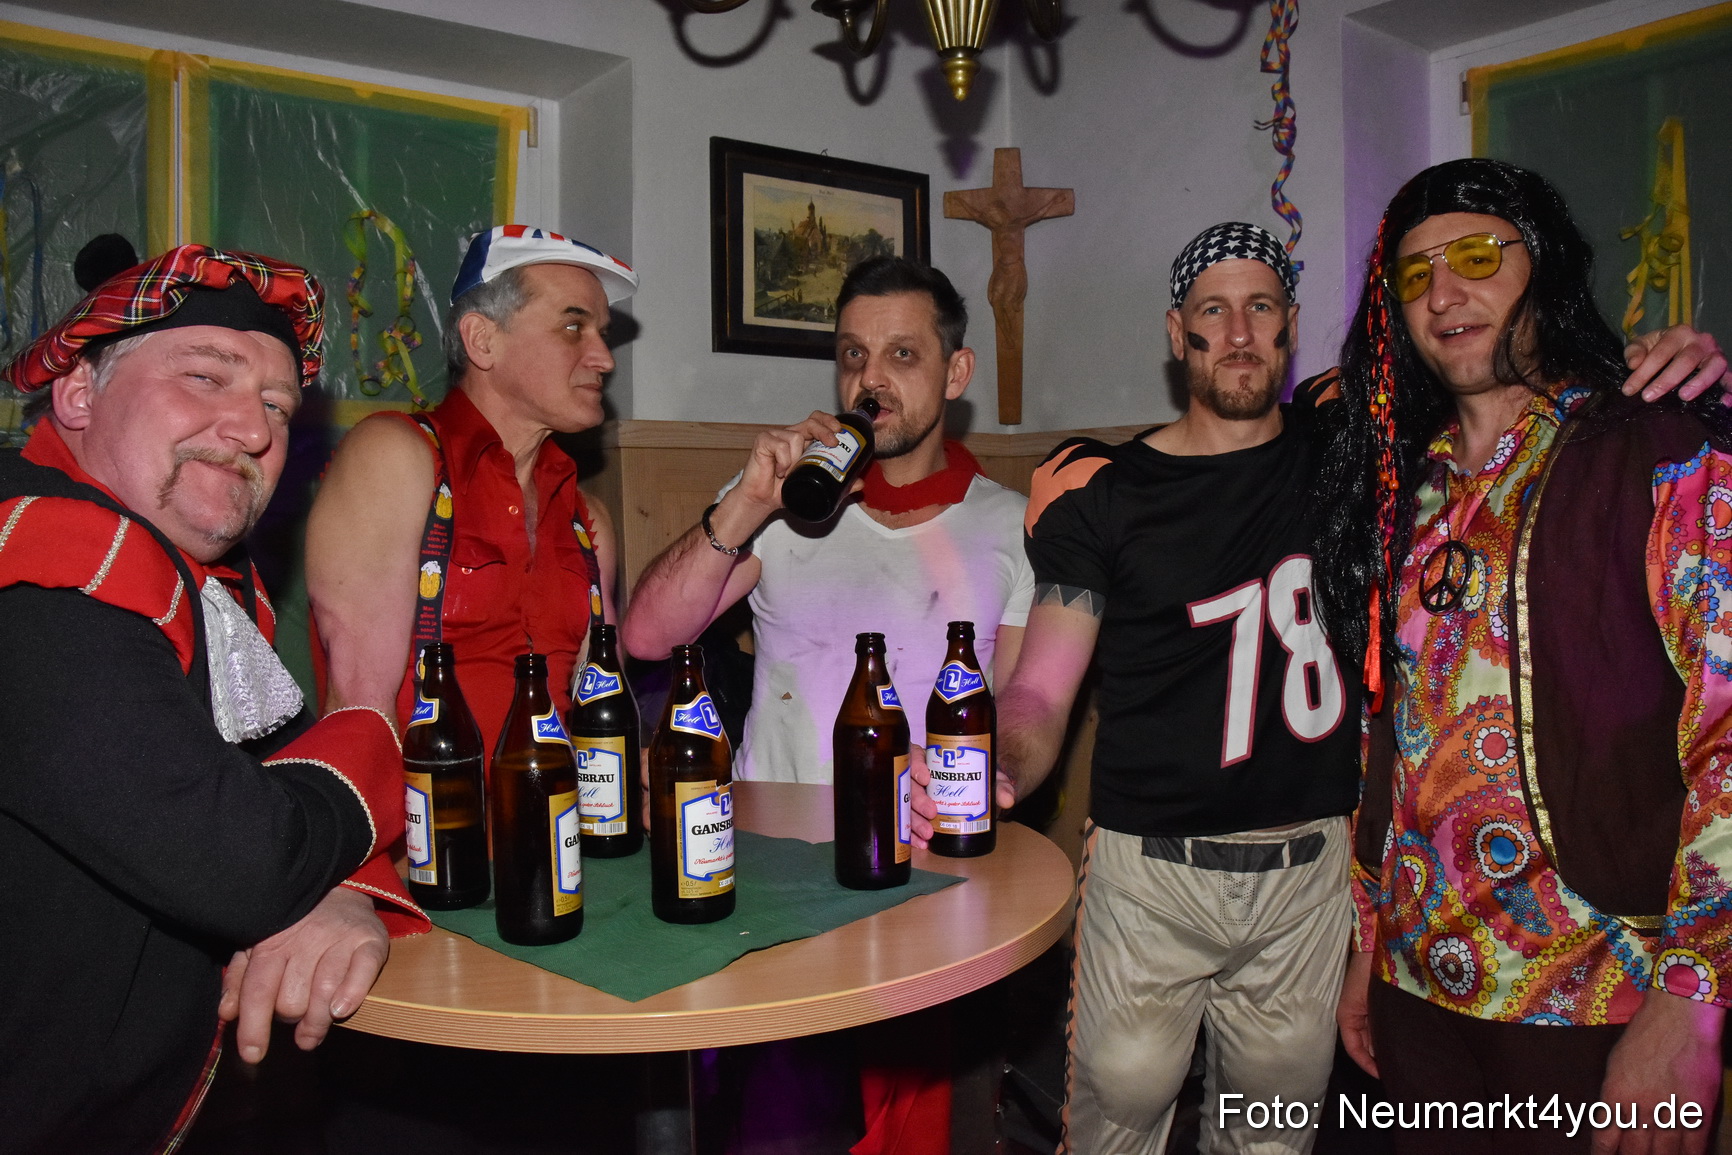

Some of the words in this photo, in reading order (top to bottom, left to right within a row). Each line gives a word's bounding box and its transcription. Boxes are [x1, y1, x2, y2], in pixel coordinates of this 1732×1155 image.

[1186, 553, 1346, 769] 78
[594, 678, 616, 690] Hell
[961, 676, 980, 687] Hell
[675, 712, 702, 724] Hell
[538, 722, 560, 733] Hell
[934, 784, 968, 798] Hell
